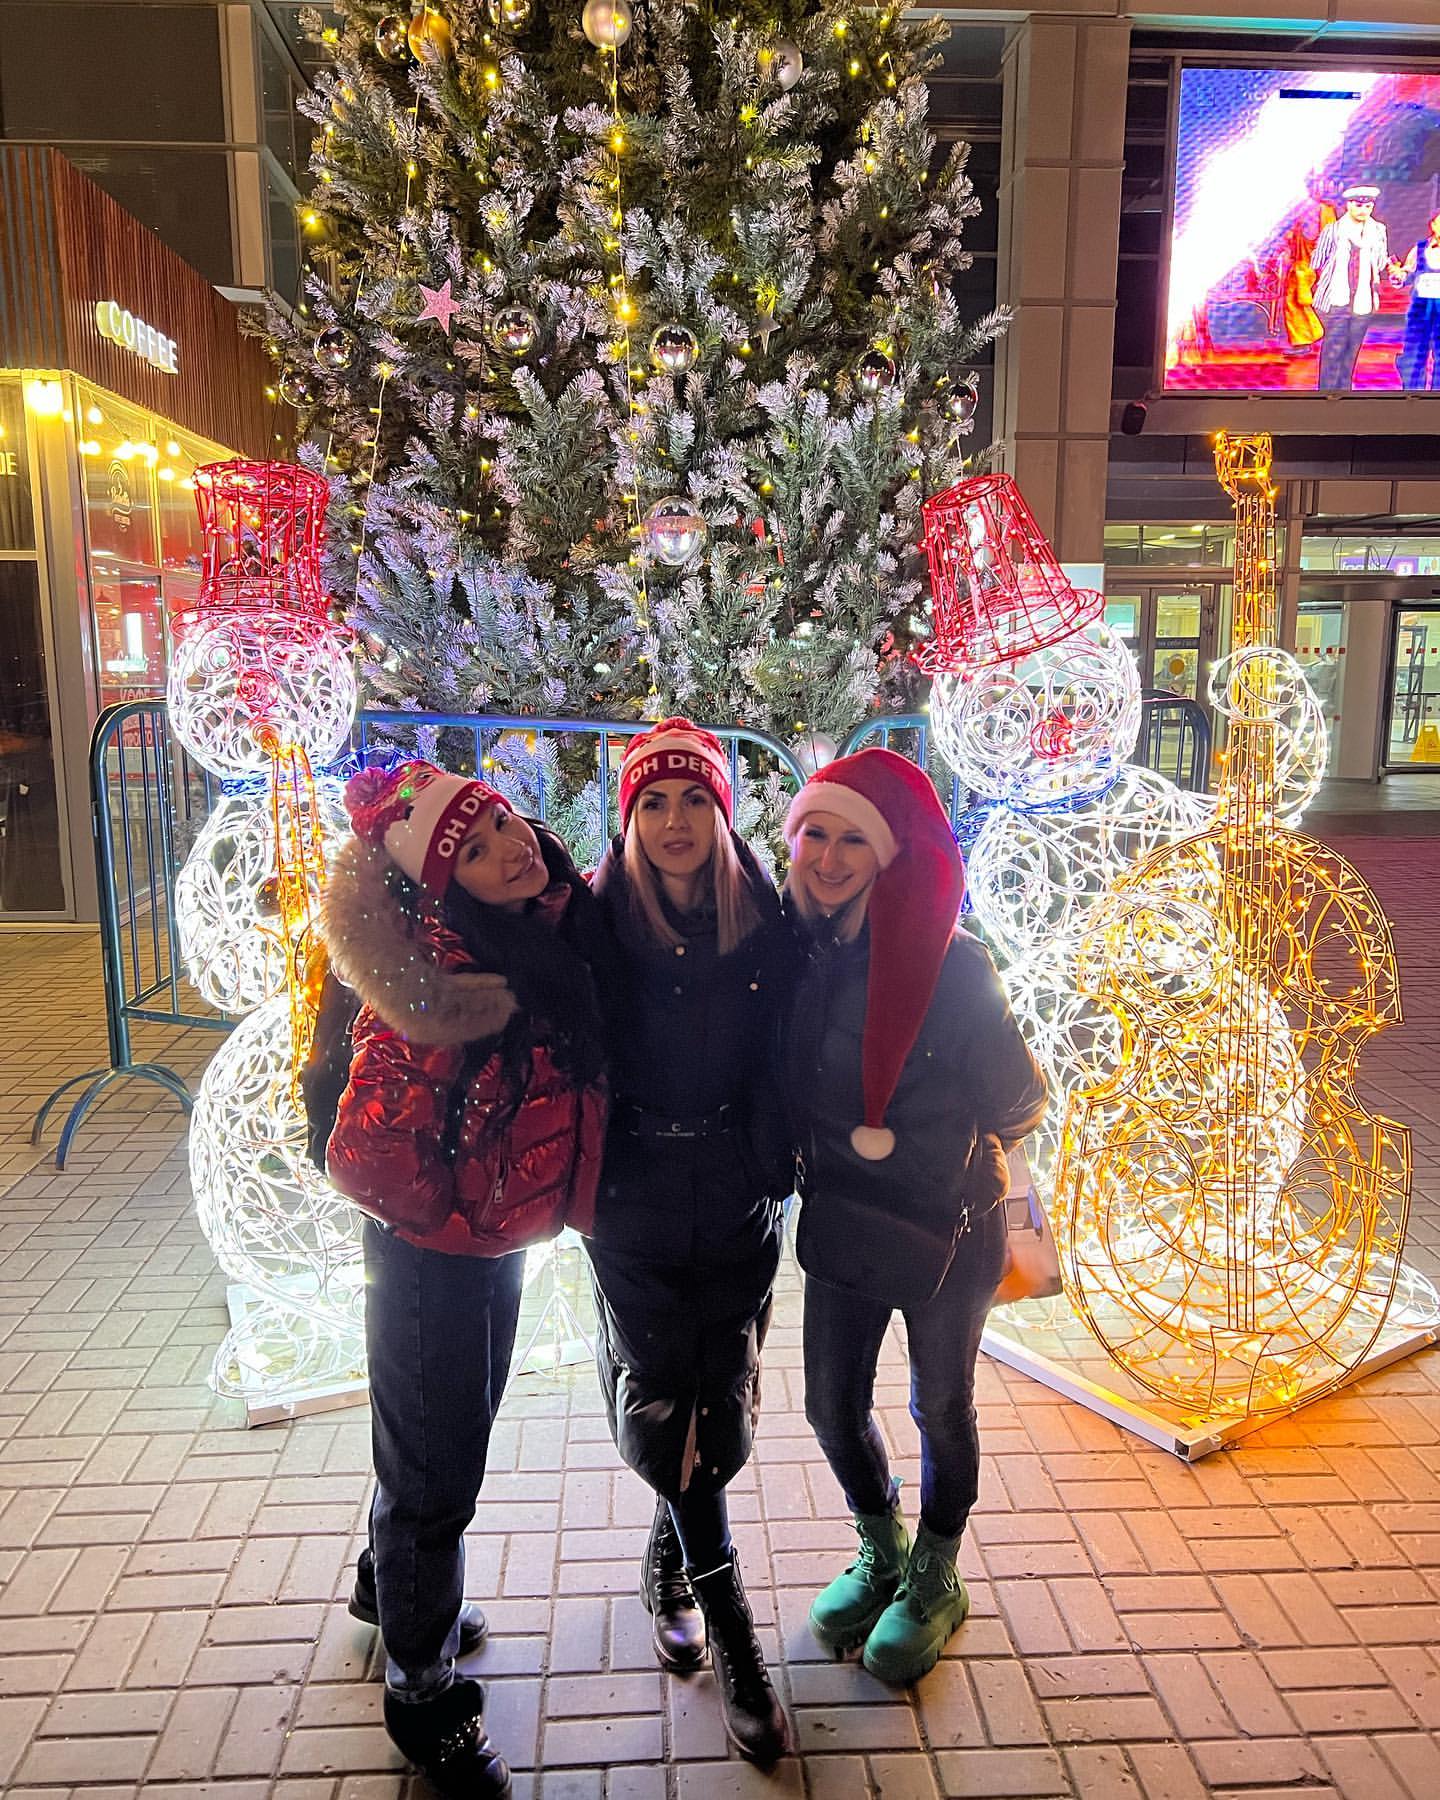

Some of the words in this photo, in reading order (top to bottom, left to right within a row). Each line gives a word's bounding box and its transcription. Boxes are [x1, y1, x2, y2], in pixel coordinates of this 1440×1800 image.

[103, 300, 179, 375] COFFEE
[629, 757, 660, 785] OH
[437, 818, 467, 858] OH
